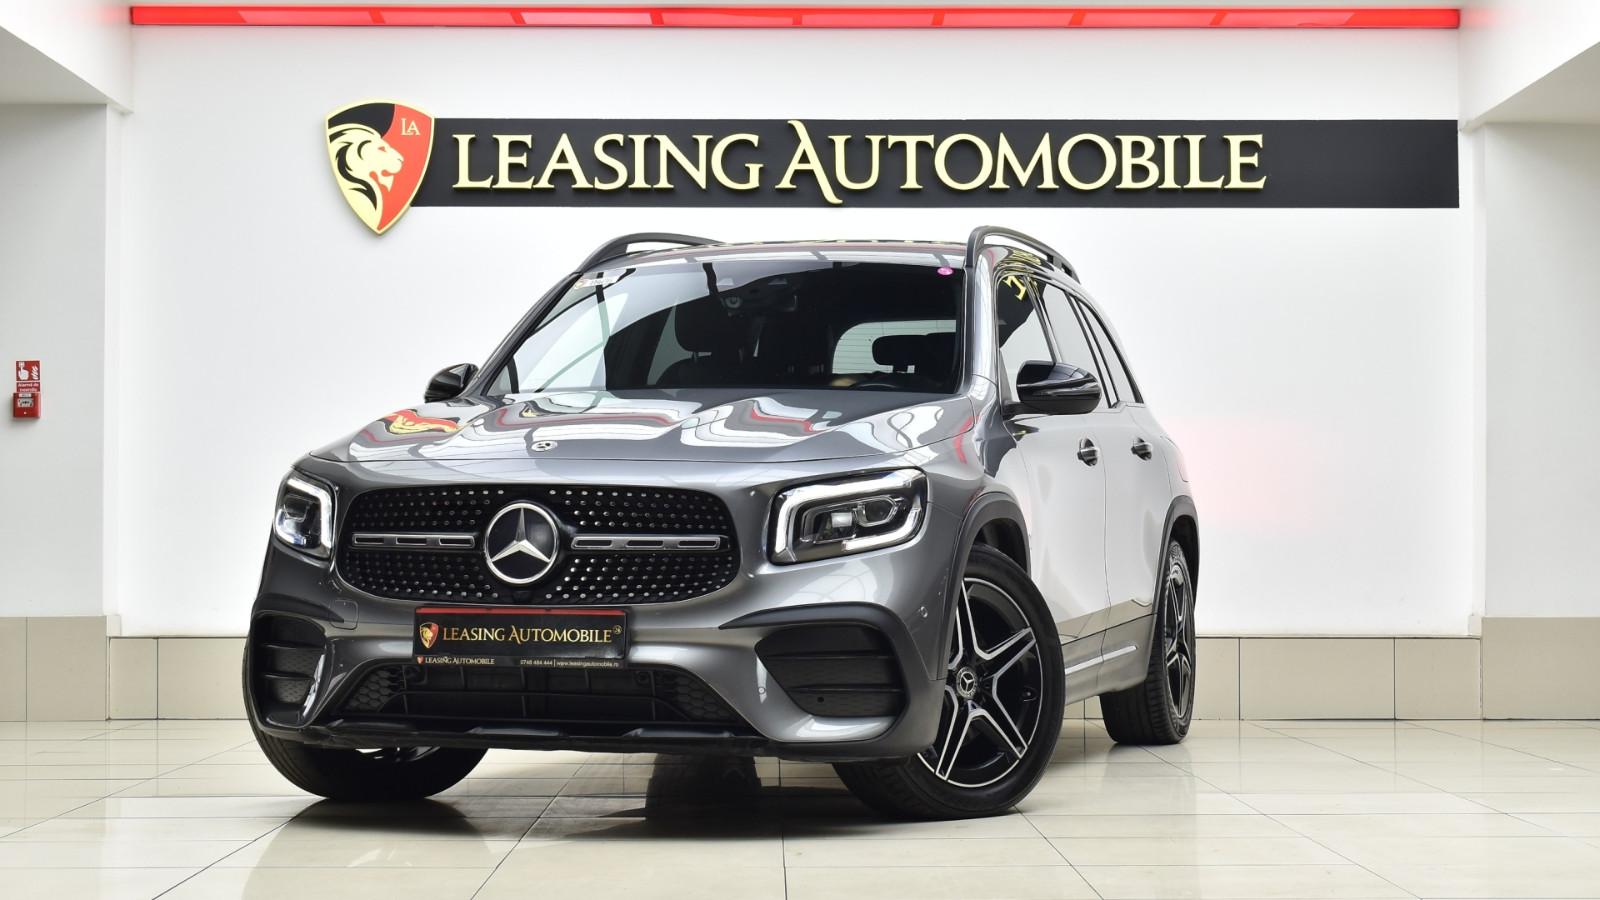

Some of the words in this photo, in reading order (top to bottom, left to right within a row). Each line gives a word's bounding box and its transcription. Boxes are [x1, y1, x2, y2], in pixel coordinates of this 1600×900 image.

[400, 117, 421, 136] LA
[452, 132, 764, 191] LEASING
[774, 119, 1268, 205] AUTOMOBILE
[442, 627, 505, 642] LEASING
[508, 625, 613, 645] AUTOMOBILE
[425, 656, 452, 664] LEASING
[452, 657, 495, 665] AUTOMOBILE
